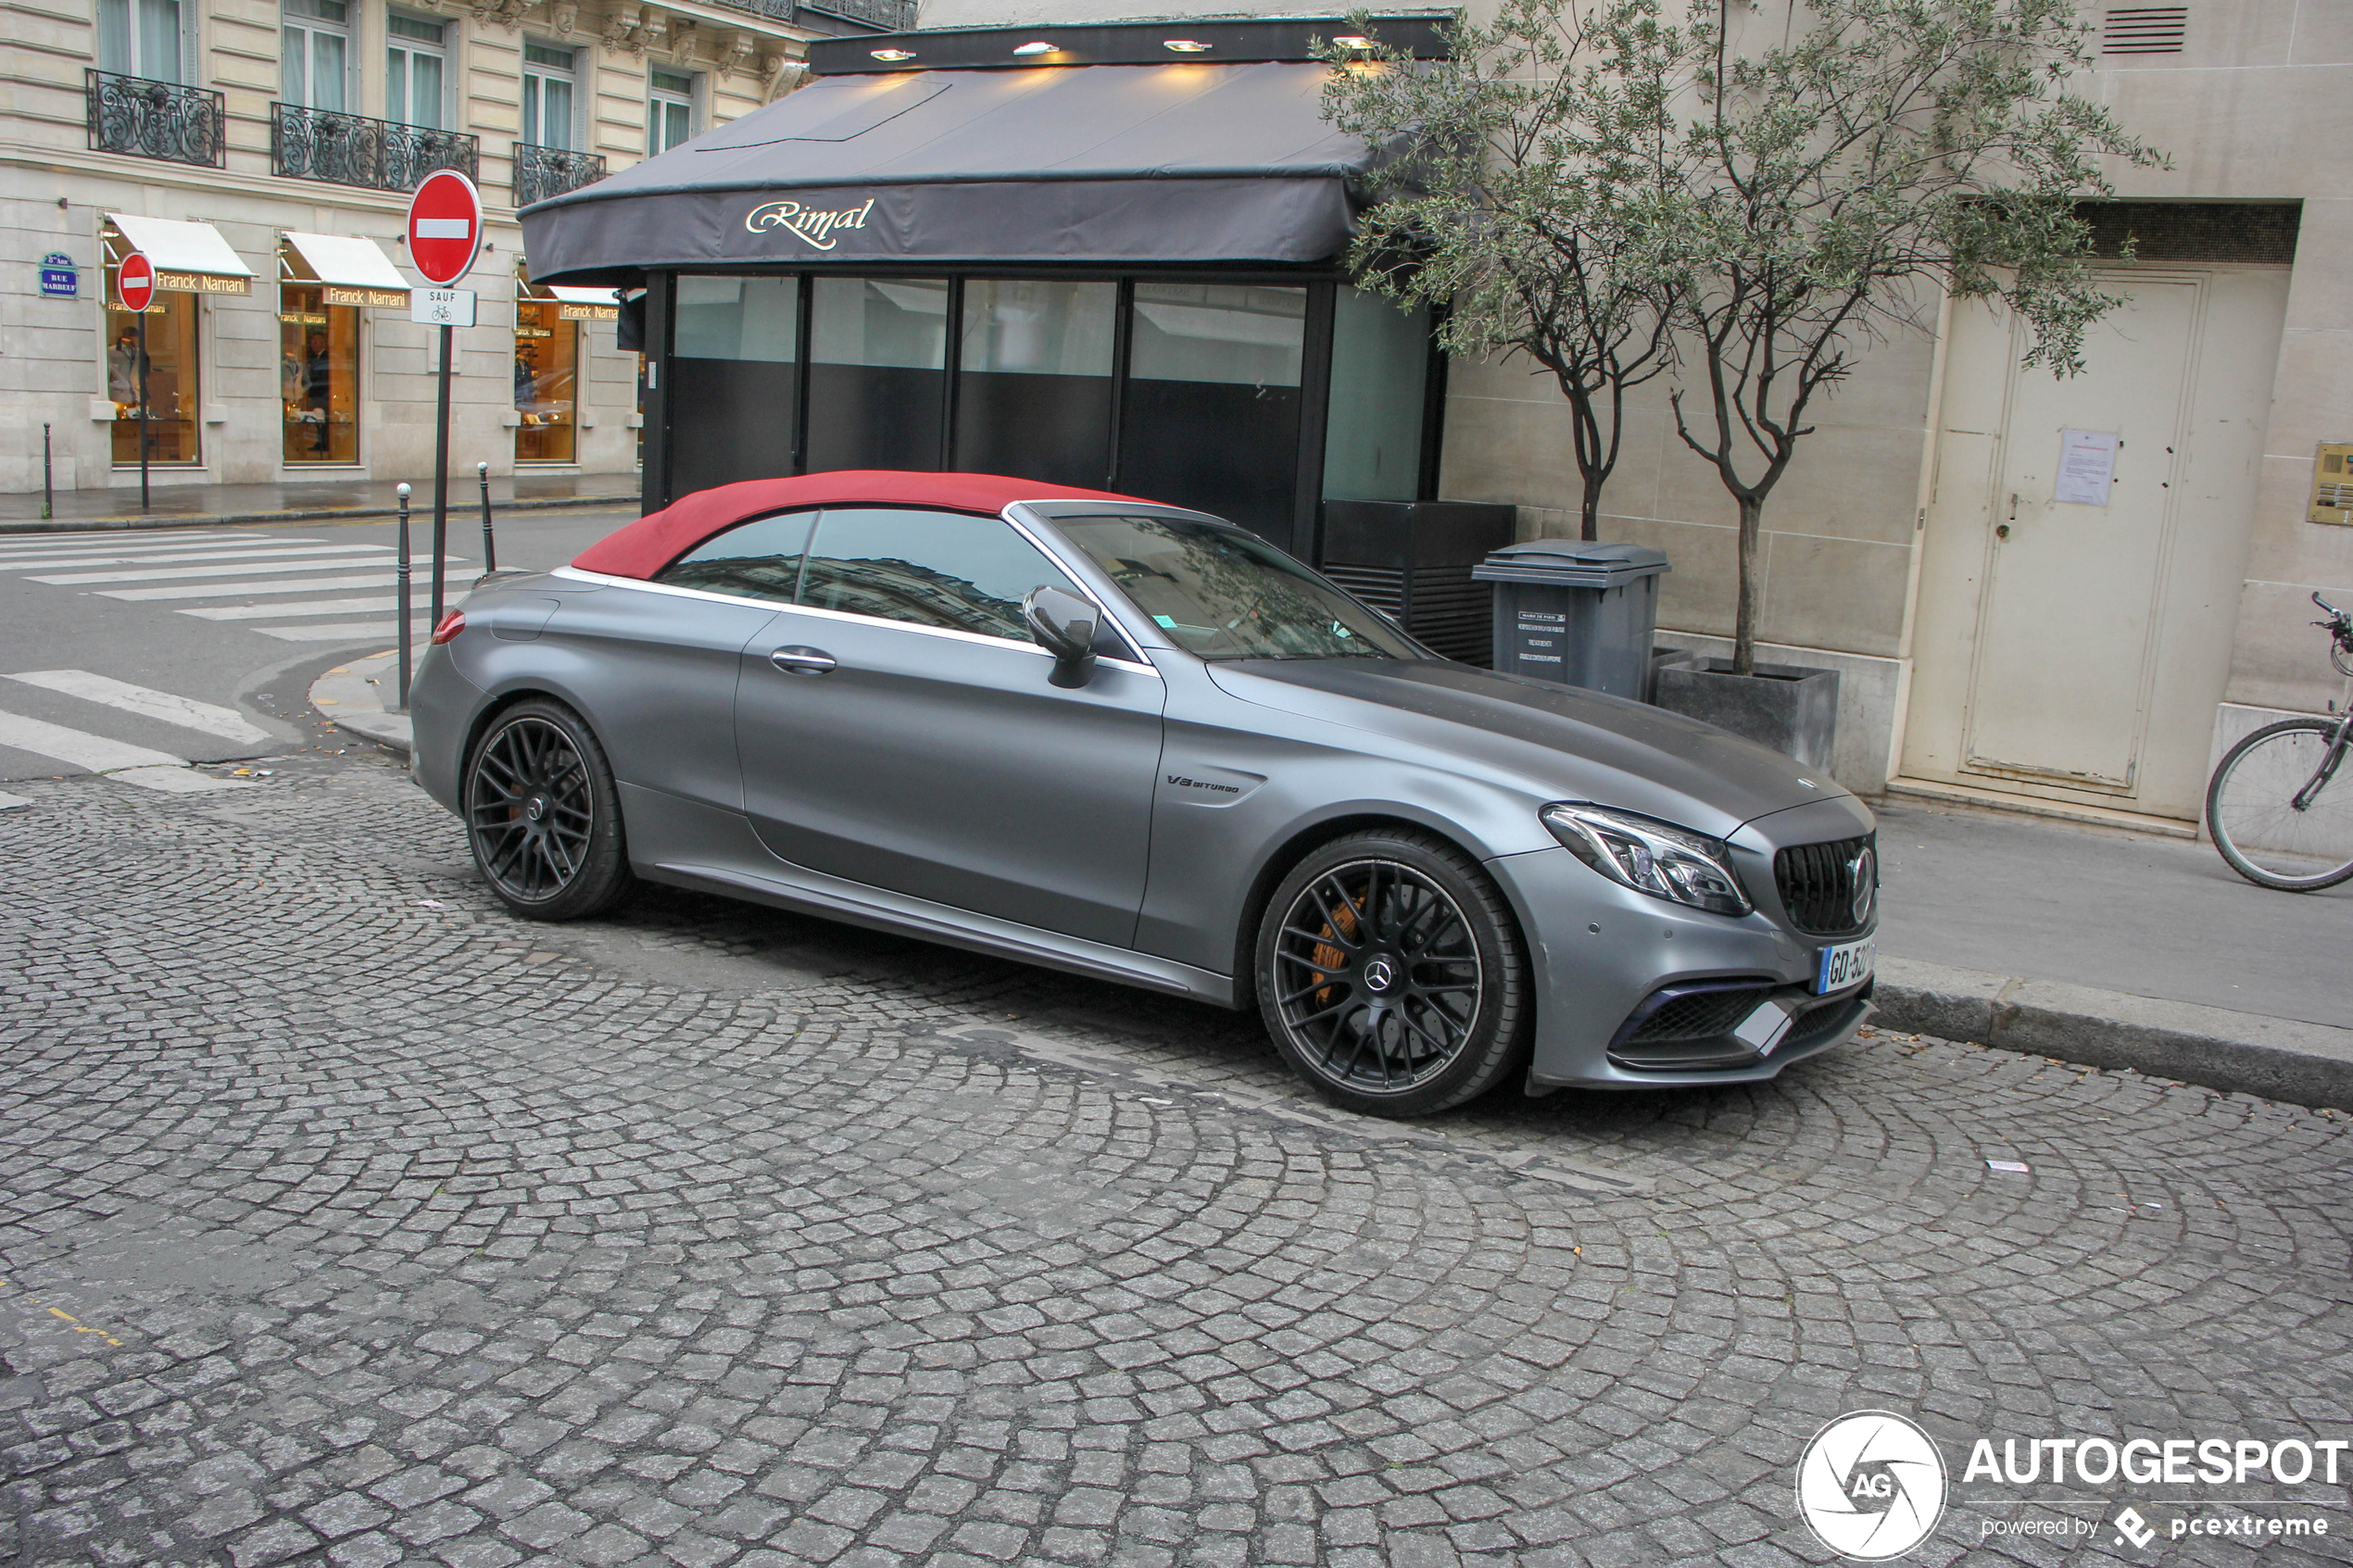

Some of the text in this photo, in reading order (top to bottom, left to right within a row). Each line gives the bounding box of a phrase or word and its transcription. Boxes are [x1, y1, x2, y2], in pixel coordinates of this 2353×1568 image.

[746, 197, 875, 251] Rimal
[51, 274, 68, 282] RUE
[157, 271, 245, 293] Franck Namani
[43, 282, 76, 292] MARBEUF
[330, 287, 405, 307] Franck Namani
[429, 291, 456, 302] SAUF
[280, 314, 327, 323] ranck Namani
[563, 304, 619, 320] Franck Nama
[1167, 774, 1239, 793] V8 BITURBO
